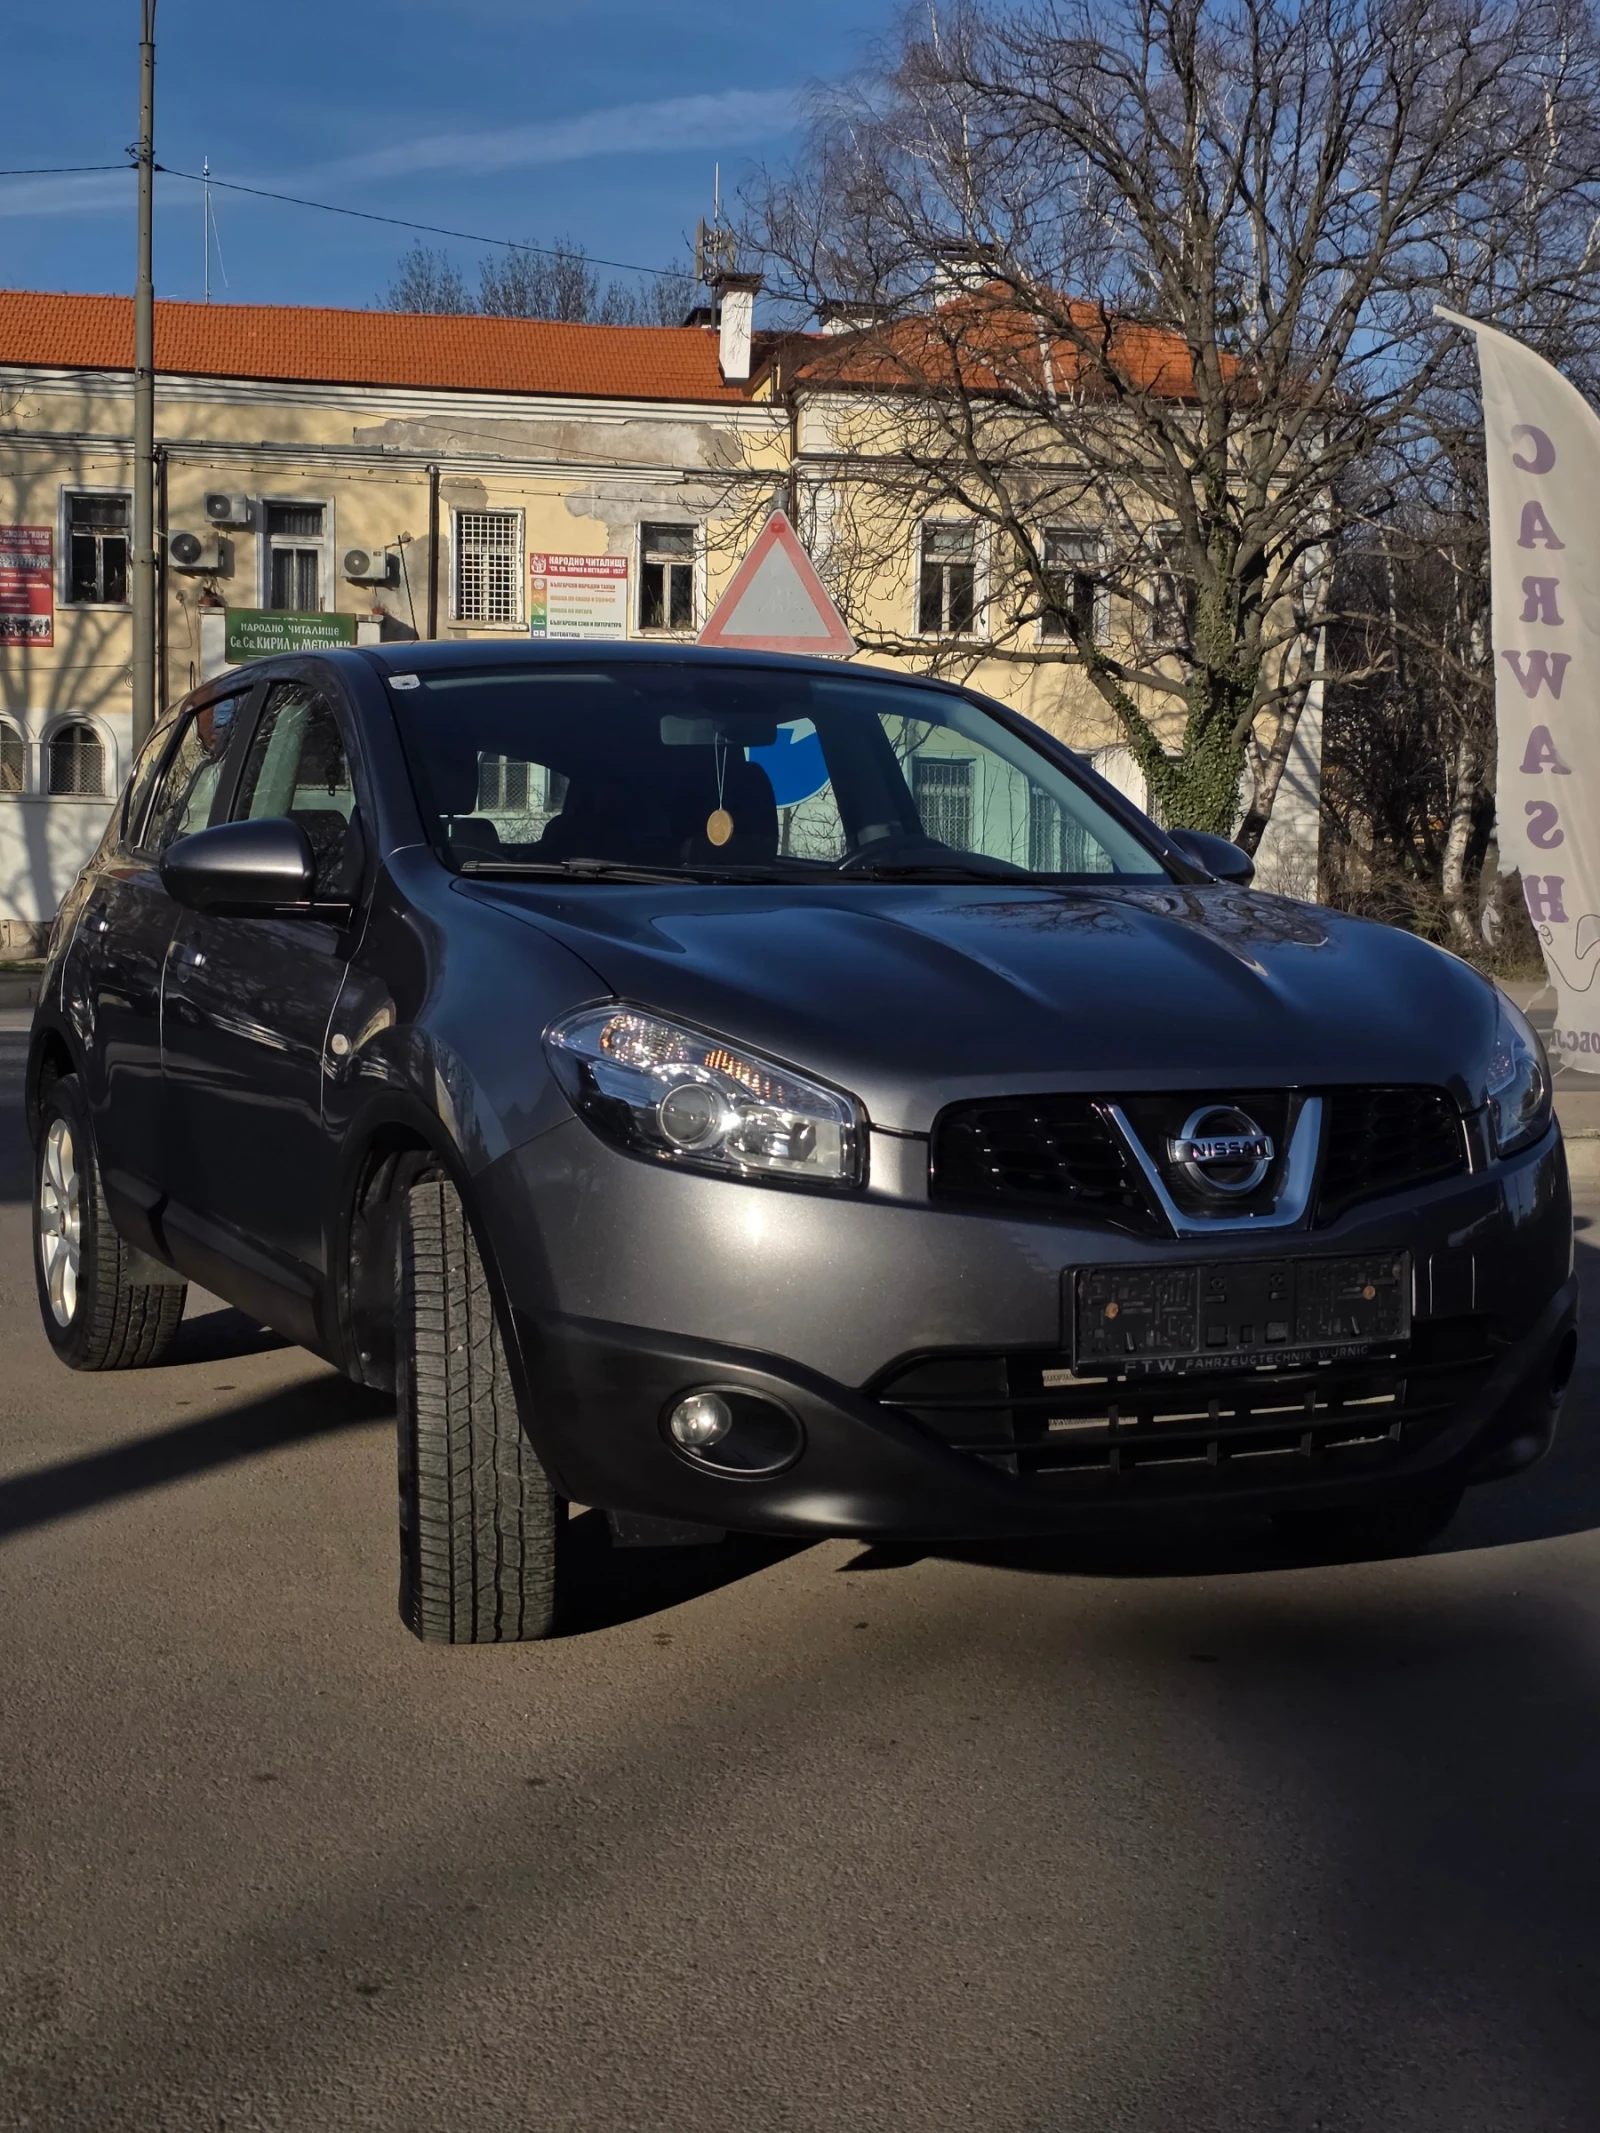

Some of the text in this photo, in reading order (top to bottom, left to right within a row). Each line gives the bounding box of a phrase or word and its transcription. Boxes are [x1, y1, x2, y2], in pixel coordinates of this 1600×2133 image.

[549, 556, 626, 568] НАРОДНО ЧИТАЛИЩЕ
[241, 623, 340, 636] НАРОДНО ЧИТАЛИЩЕ
[257, 636, 290, 650] КИРИЛ
[1191, 1140, 1267, 1158] NISSAN
[1186, 1350, 1312, 1369] FAHRZEUGTECHNIK
